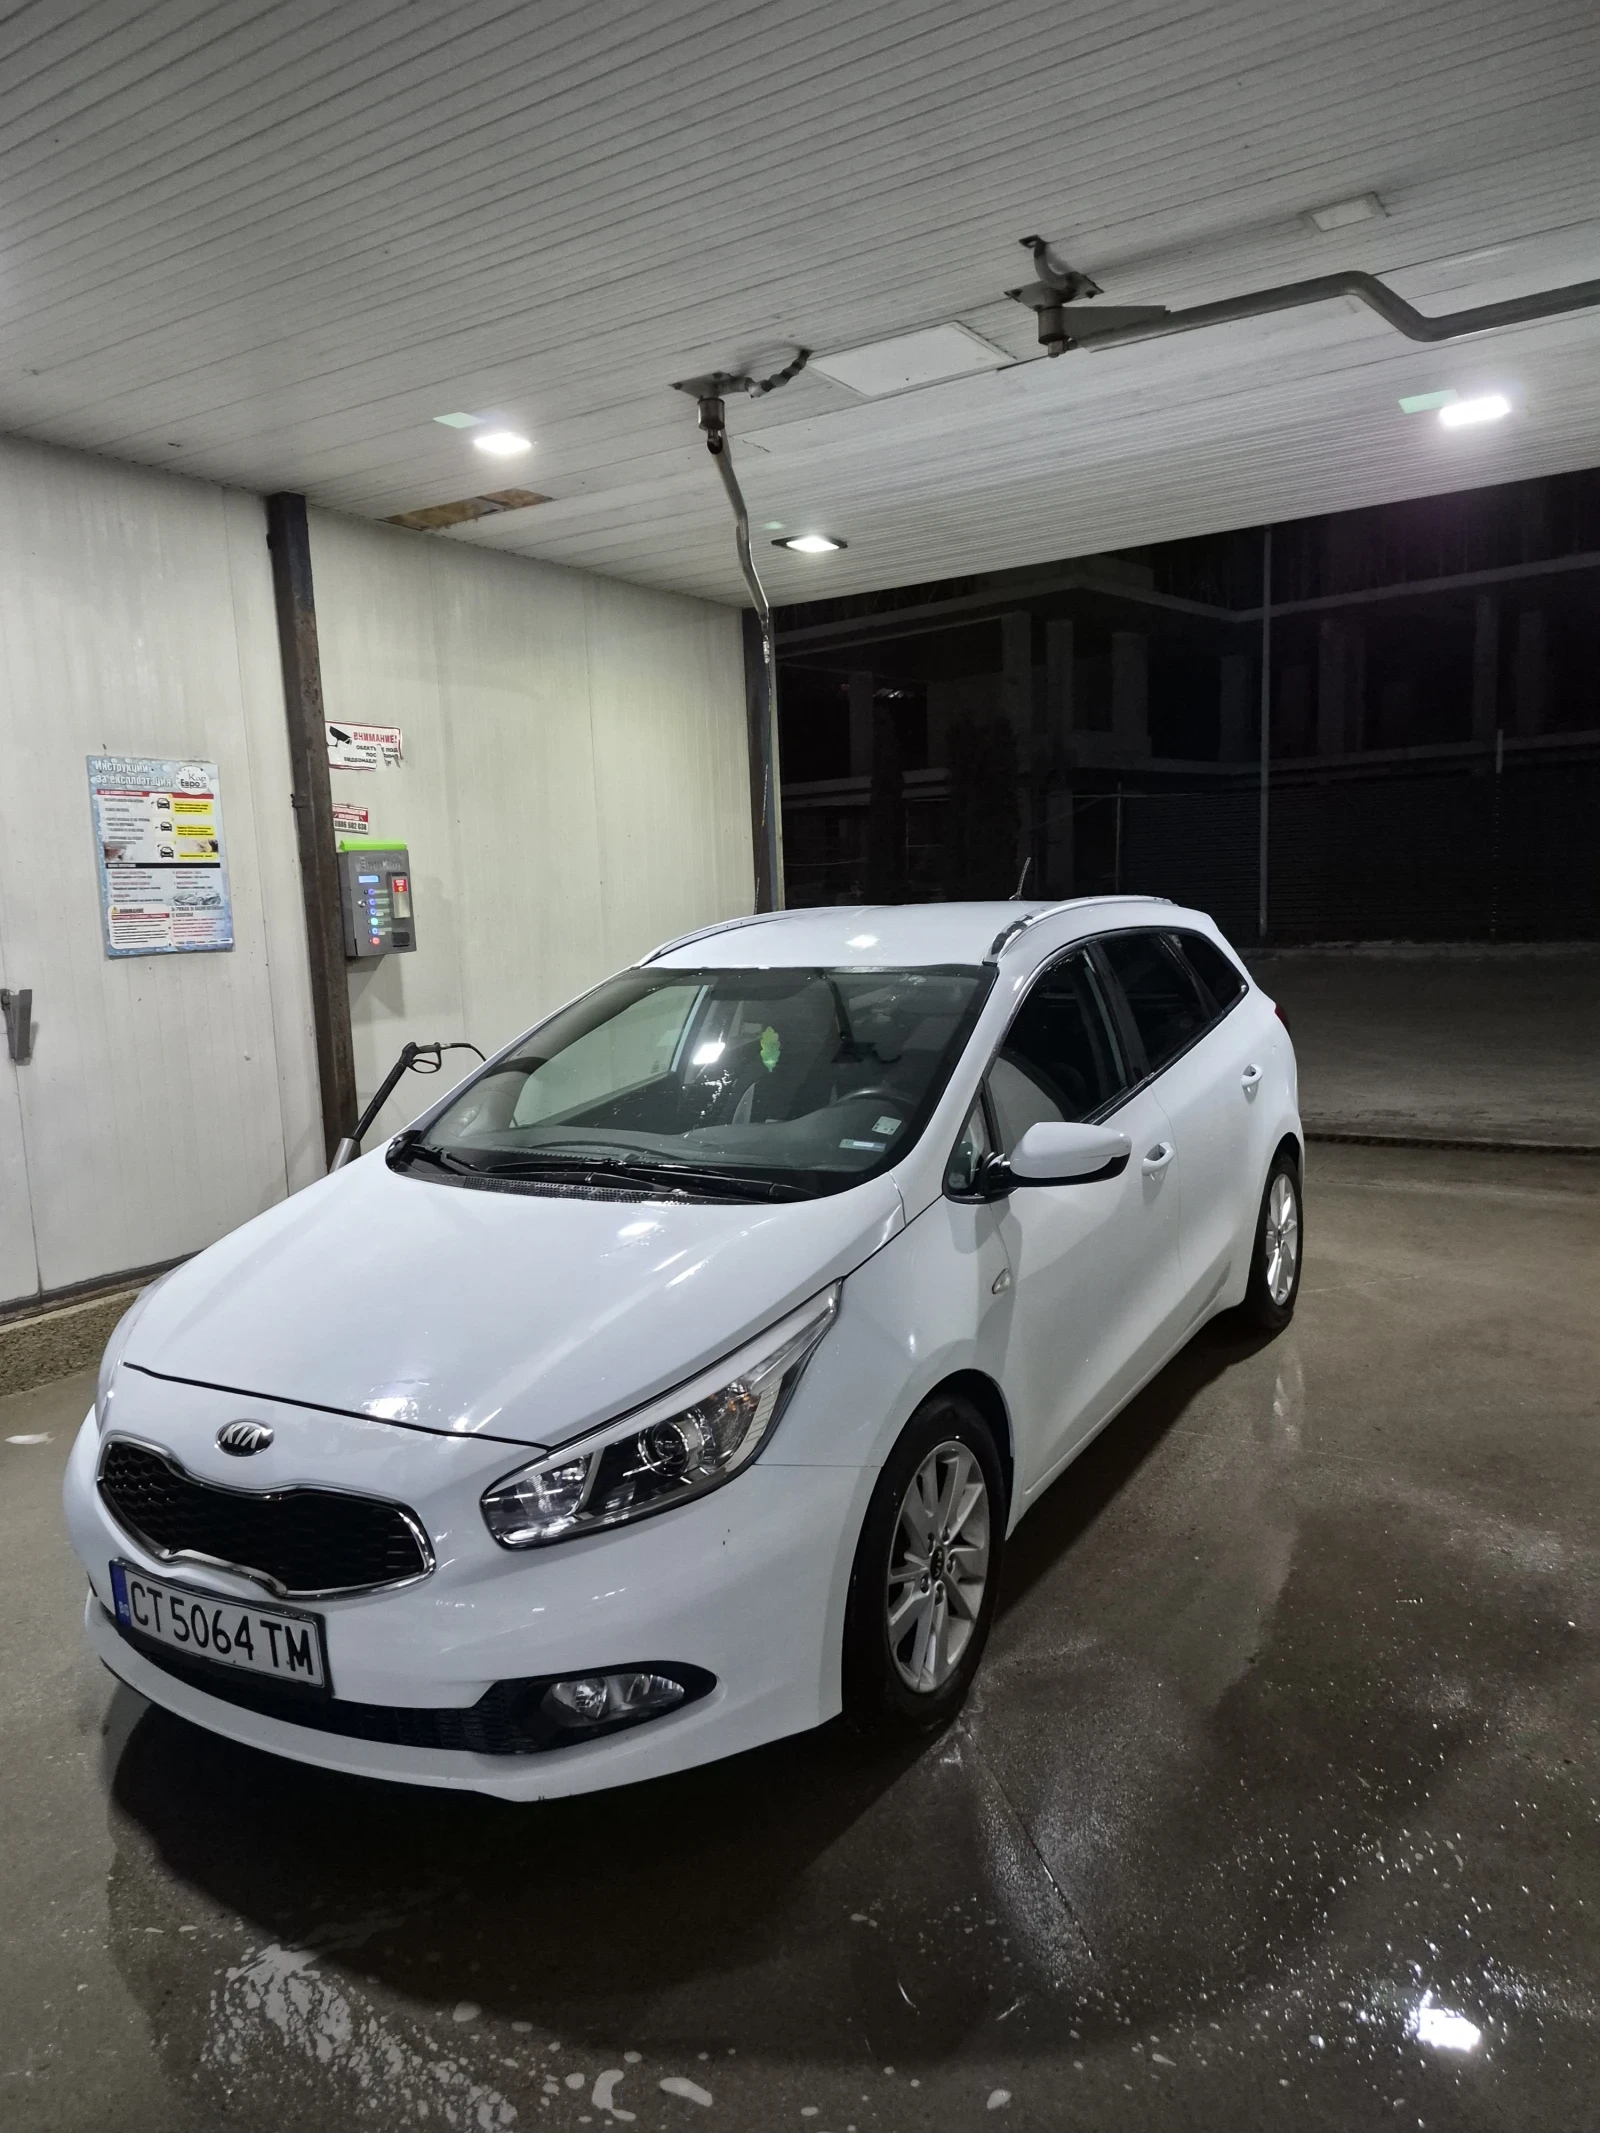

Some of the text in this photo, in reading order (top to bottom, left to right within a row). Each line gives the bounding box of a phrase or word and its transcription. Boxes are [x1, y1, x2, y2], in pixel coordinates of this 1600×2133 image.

[353, 731, 398, 744] ВНИМАНИЕ!
[94, 760, 149, 773] Инструкции
[110, 775, 173, 787] експлоатация
[180, 779, 201, 789] Евро
[220, 1423, 261, 1449] KIA
